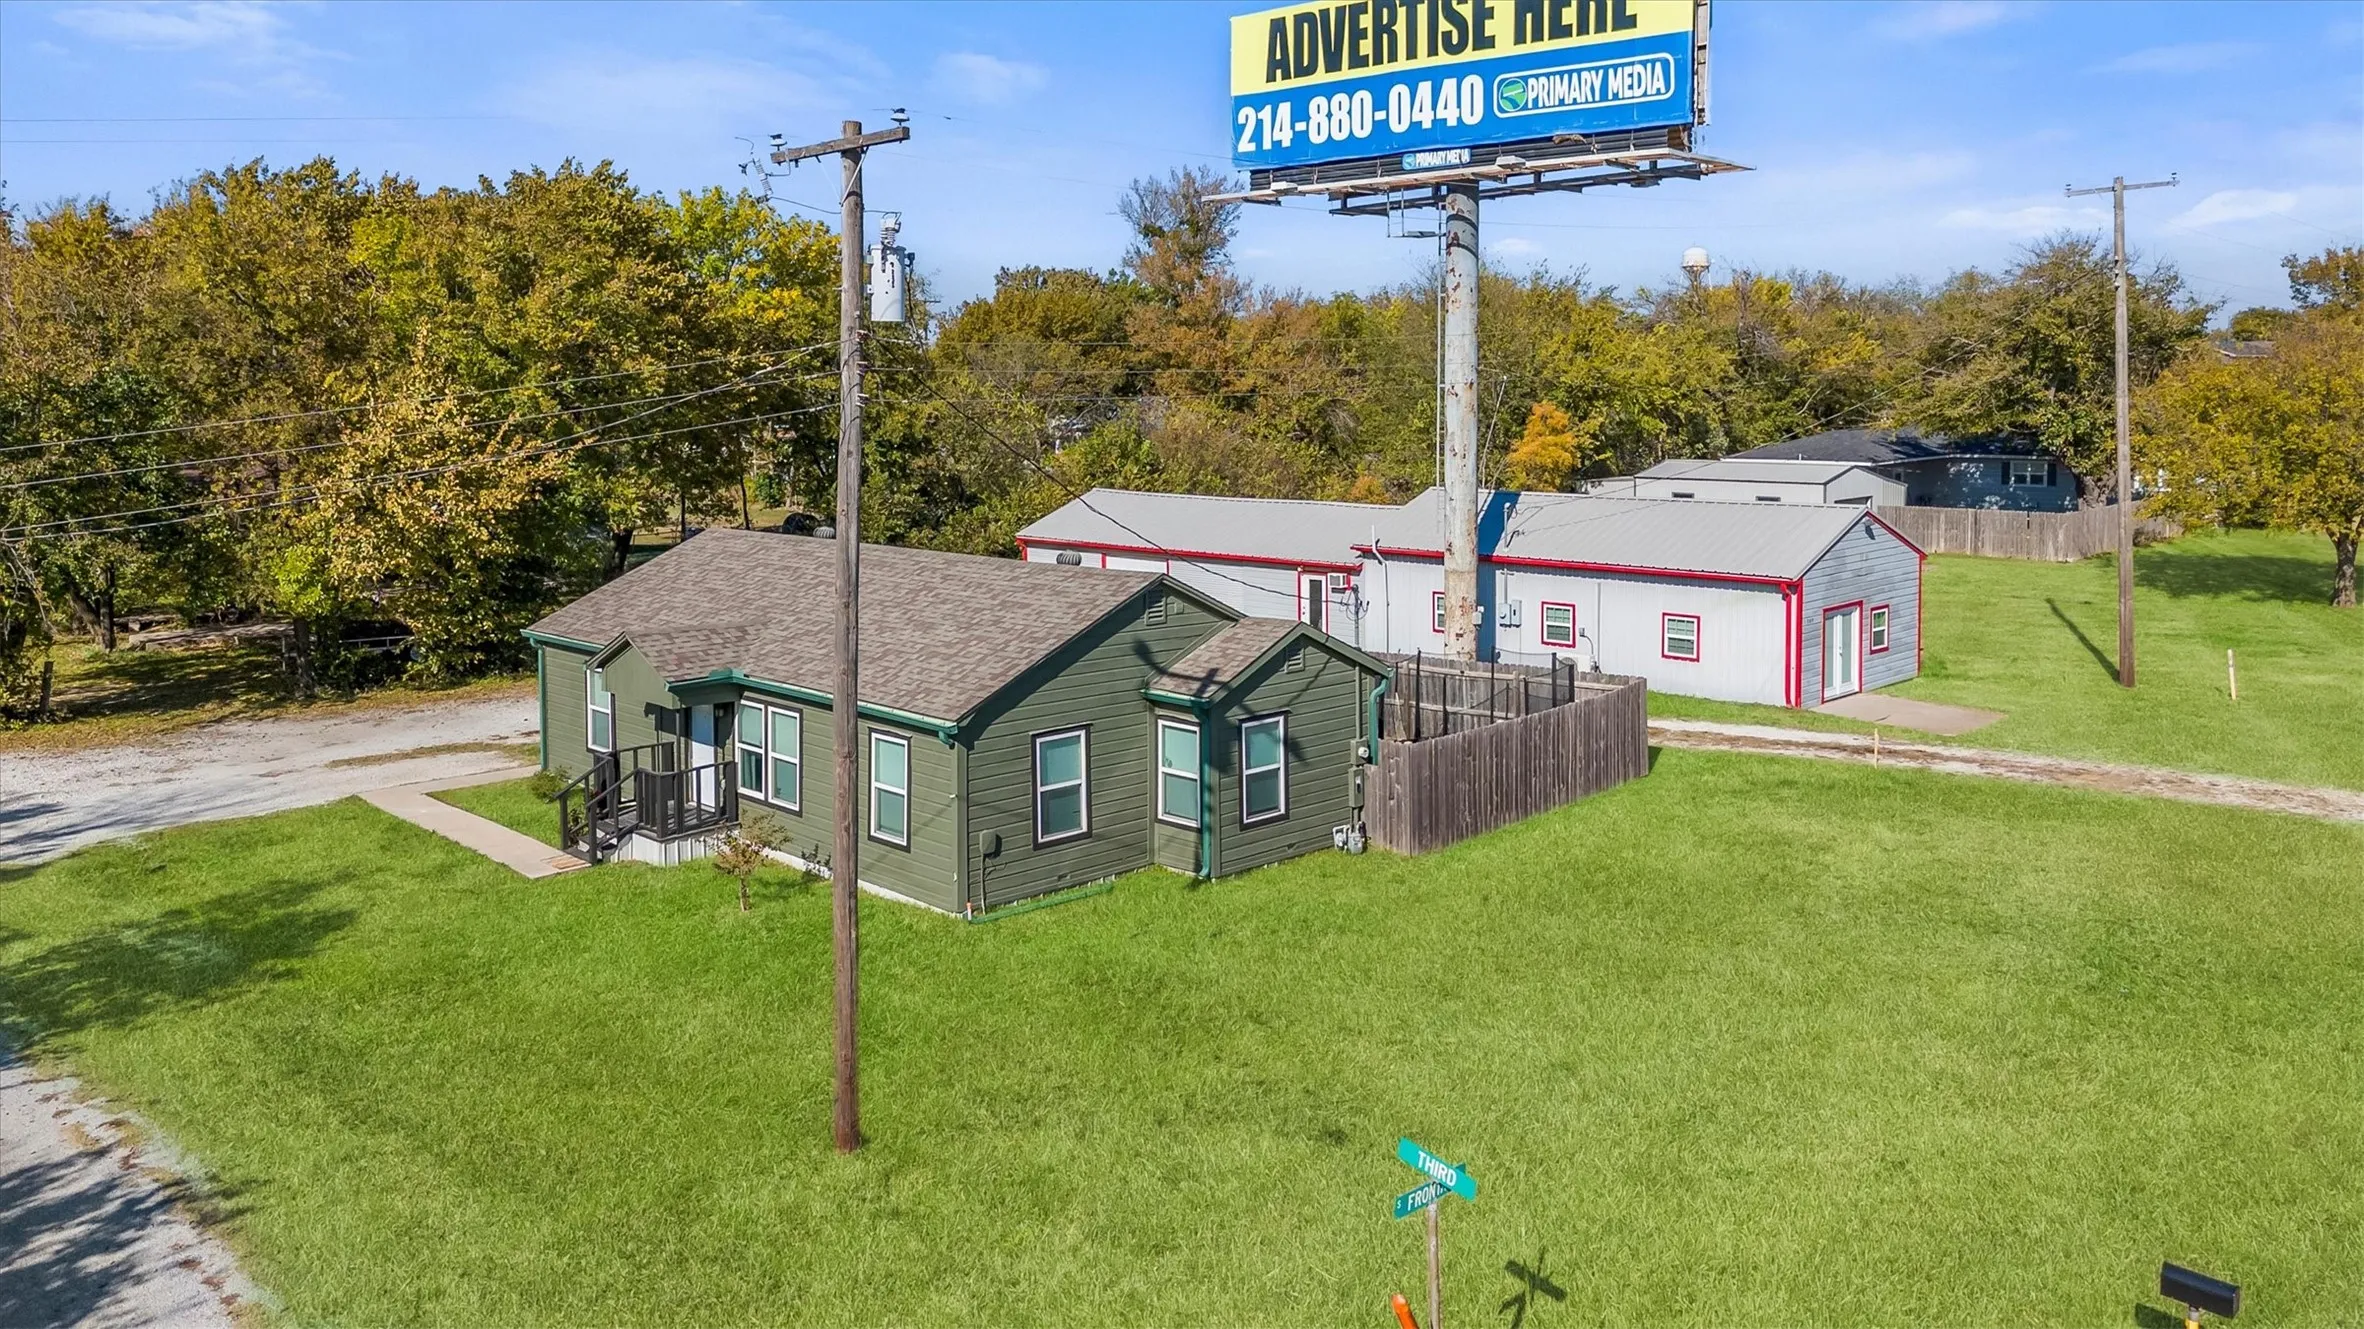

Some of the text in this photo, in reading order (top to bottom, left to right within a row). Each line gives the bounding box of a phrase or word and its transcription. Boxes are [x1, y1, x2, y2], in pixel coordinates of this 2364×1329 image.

[1265, 0, 1496, 83] ADVERTISE
[1526, 61, 1666, 110] PRIMARY MEDIA
[1237, 74, 1484, 153] 214-880-0440
[1415, 150, 1447, 168] PRIMARY
[1417, 1150, 1458, 1187] THIRD
[1396, 1199, 1402, 1210] S
